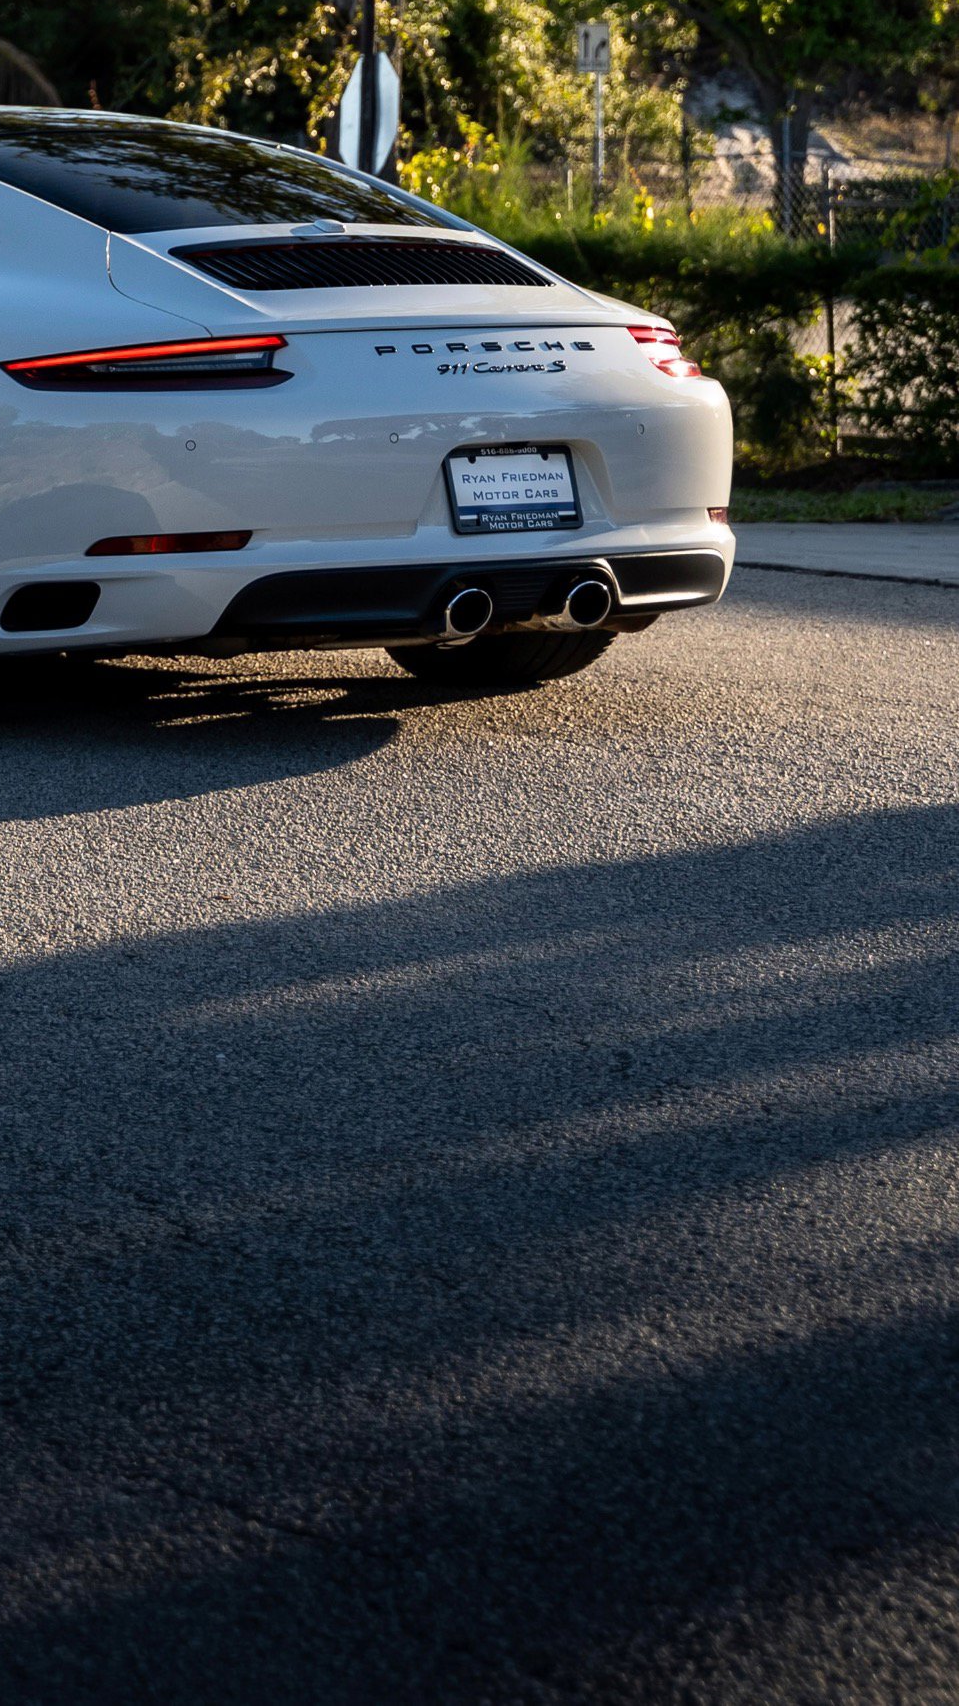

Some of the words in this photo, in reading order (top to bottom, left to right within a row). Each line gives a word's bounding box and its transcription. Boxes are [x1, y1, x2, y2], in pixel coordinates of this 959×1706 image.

[374, 340, 596, 357] PORSCHE
[437, 362, 472, 374] 911
[473, 362, 547, 374] Carrera
[547, 360, 568, 373] S
[462, 474, 496, 484] RYAN
[502, 472, 564, 483] FRIEDMAN
[473, 491, 520, 501] MOTOR
[525, 488, 559, 498] CARS
[481, 513, 508, 522] RYAN
[510, 511, 559, 521] FRIEDMAN
[489, 520, 523, 530] MOTOR
[527, 519, 554, 528] CARS
